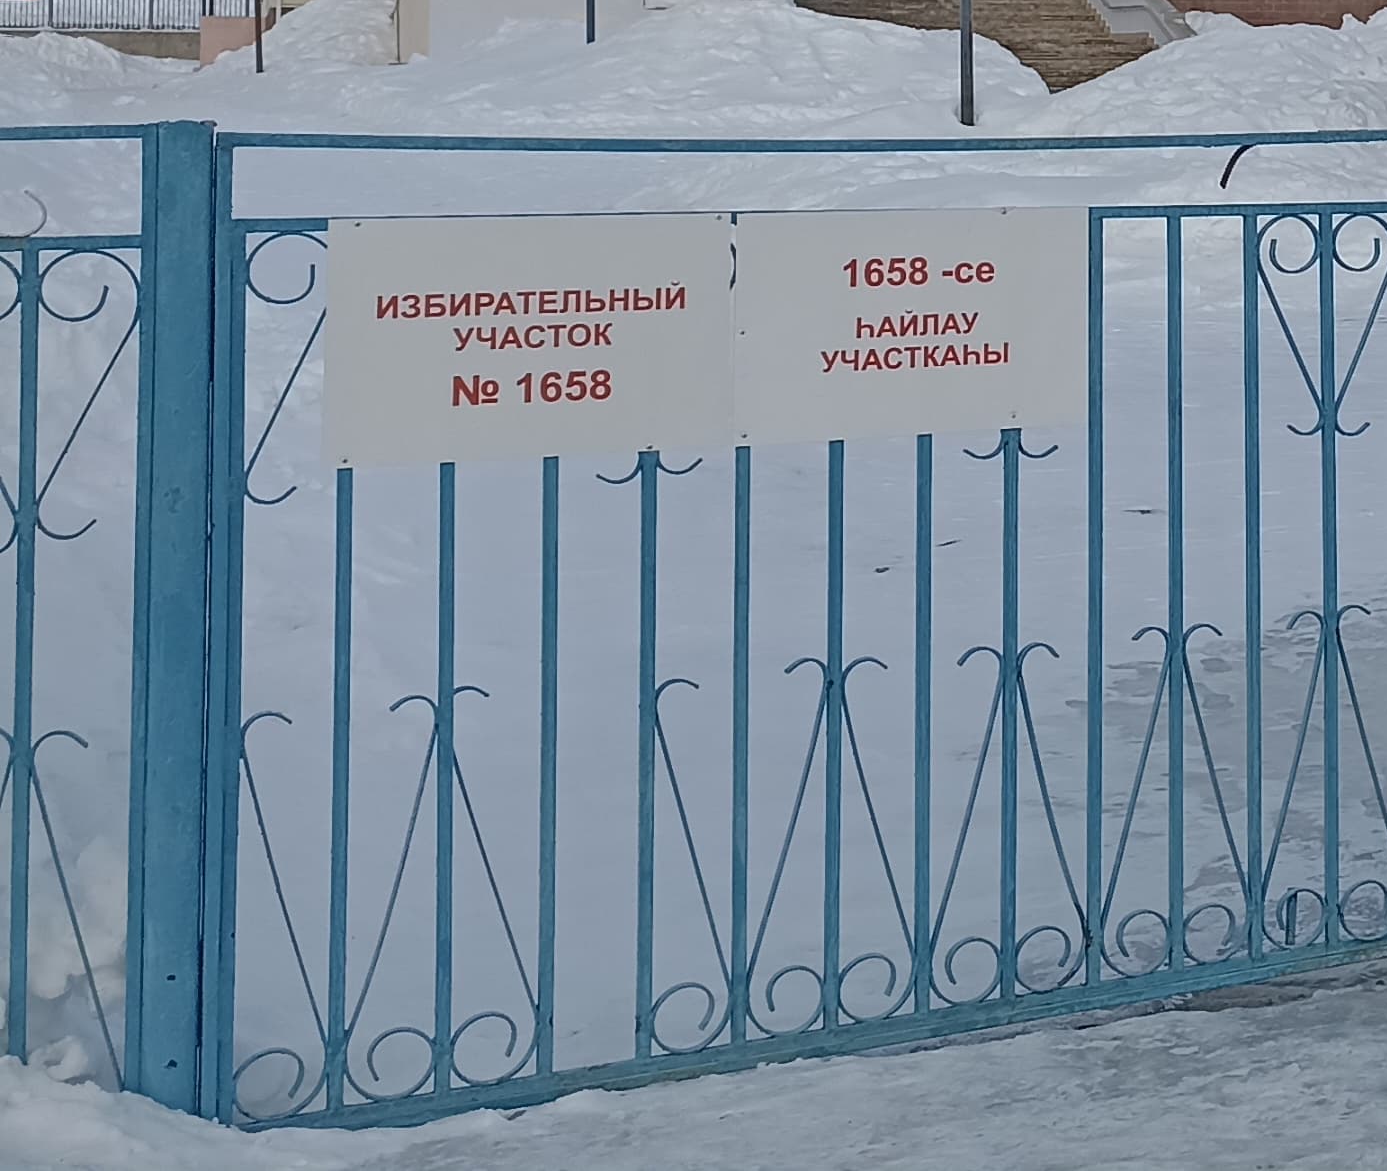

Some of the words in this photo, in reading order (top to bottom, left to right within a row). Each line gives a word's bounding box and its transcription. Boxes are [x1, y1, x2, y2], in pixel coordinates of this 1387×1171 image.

[843, 256, 929, 287] 1658
[376, 280, 686, 319] ИЗБИРАТЕЛЬНЫЙ
[453, 322, 613, 351] УЧАСТОК
[452, 374, 500, 407] №
[516, 369, 612, 404] 1658
